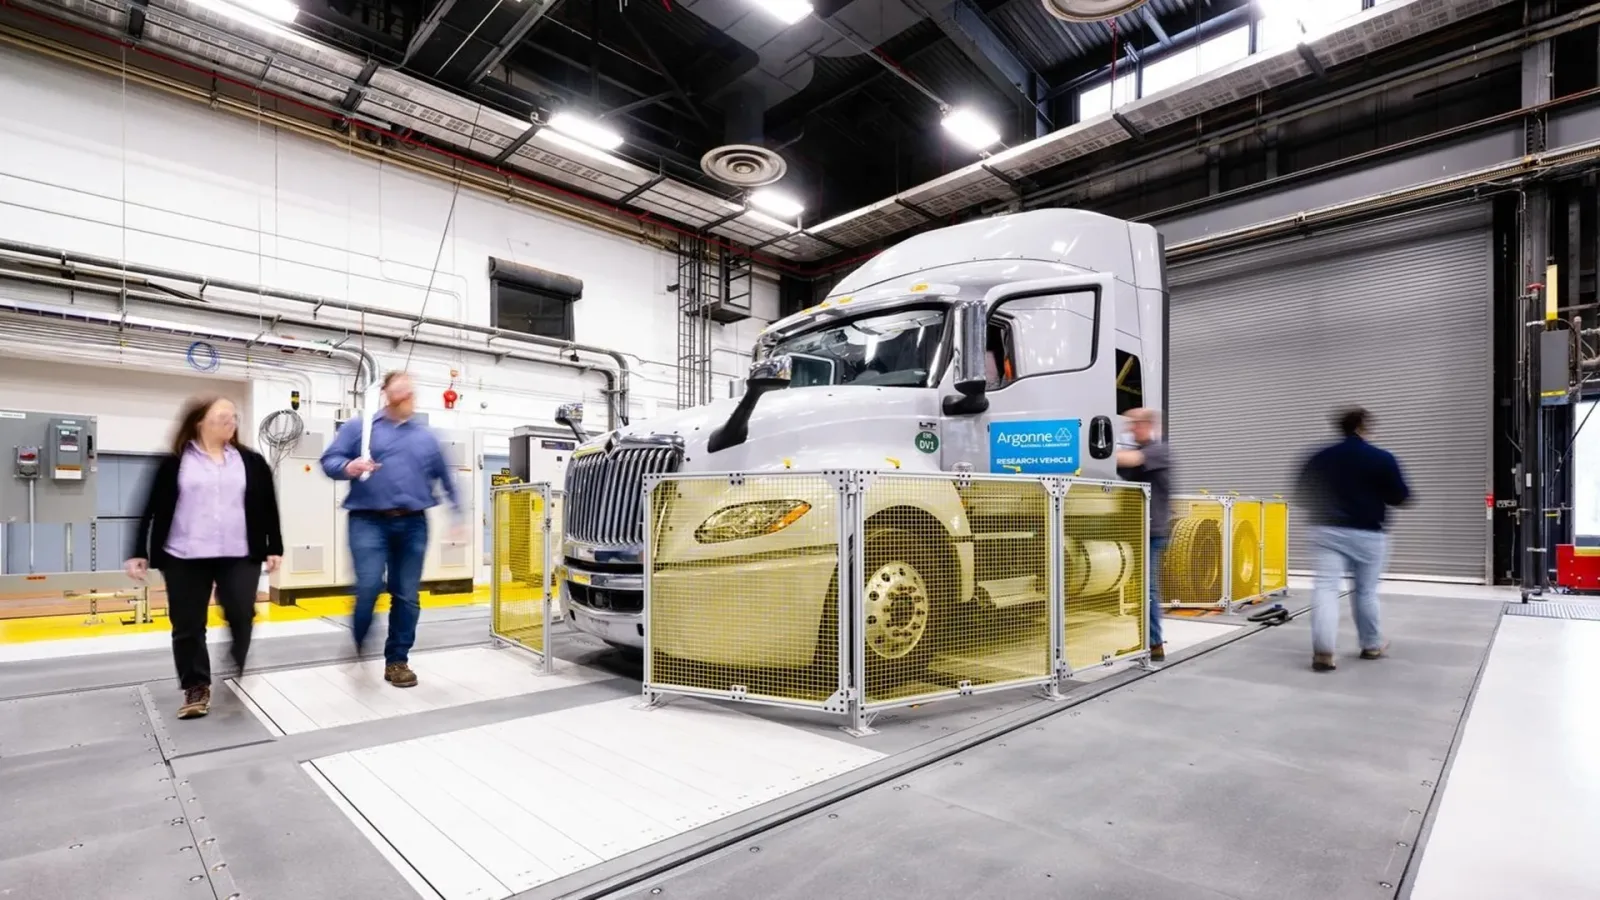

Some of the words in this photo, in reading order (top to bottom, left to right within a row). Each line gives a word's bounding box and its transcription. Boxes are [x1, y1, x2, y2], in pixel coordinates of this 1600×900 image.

[996, 431, 1053, 447] Argonne
[919, 440, 935, 450] DV1
[996, 457, 1038, 465] RESEARCH
[1039, 456, 1073, 464] VEHICLE
